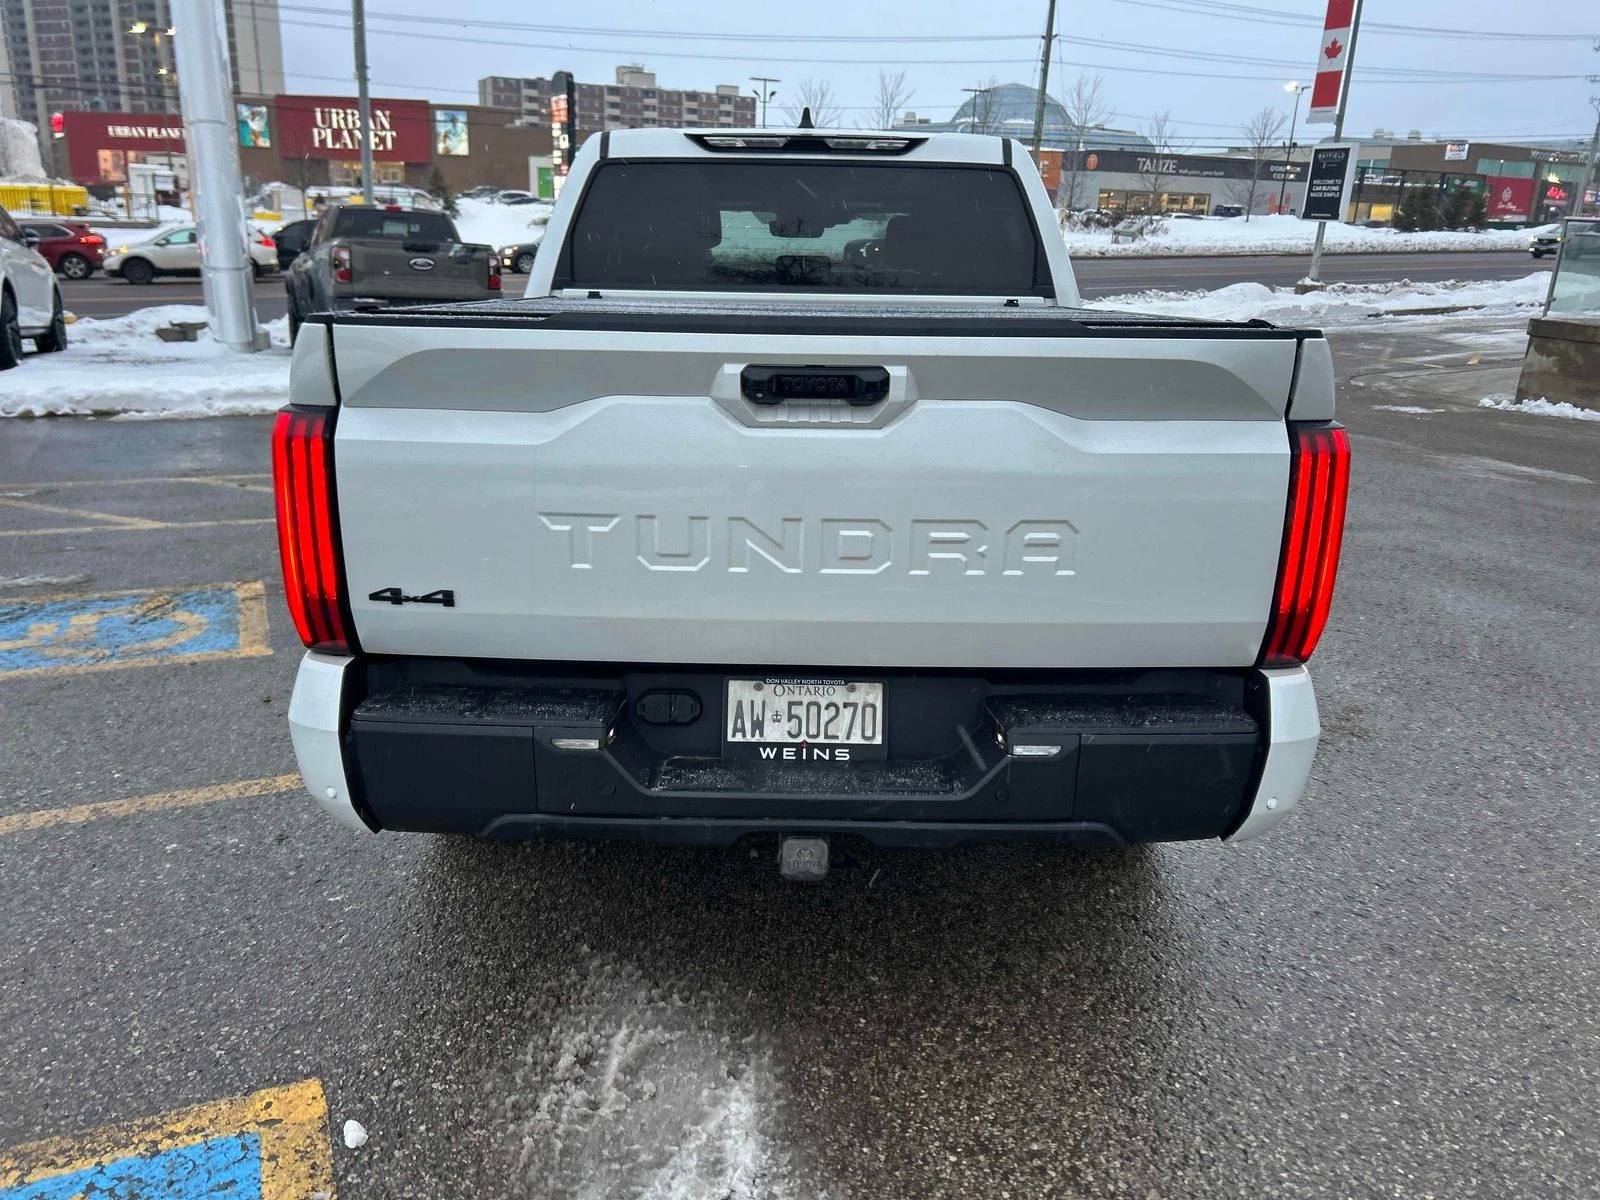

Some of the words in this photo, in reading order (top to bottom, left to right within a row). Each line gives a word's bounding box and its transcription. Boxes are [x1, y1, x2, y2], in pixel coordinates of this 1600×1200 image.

[1137, 157, 1178, 173] TALIZE
[1270, 165, 1302, 173] DONAION
[781, 377, 849, 392] TOYOTA
[537, 511, 1081, 577] TUNDRA
[773, 684, 836, 698] ONTARIO
[731, 700, 766, 738] AW
[786, 700, 878, 741] 50270
